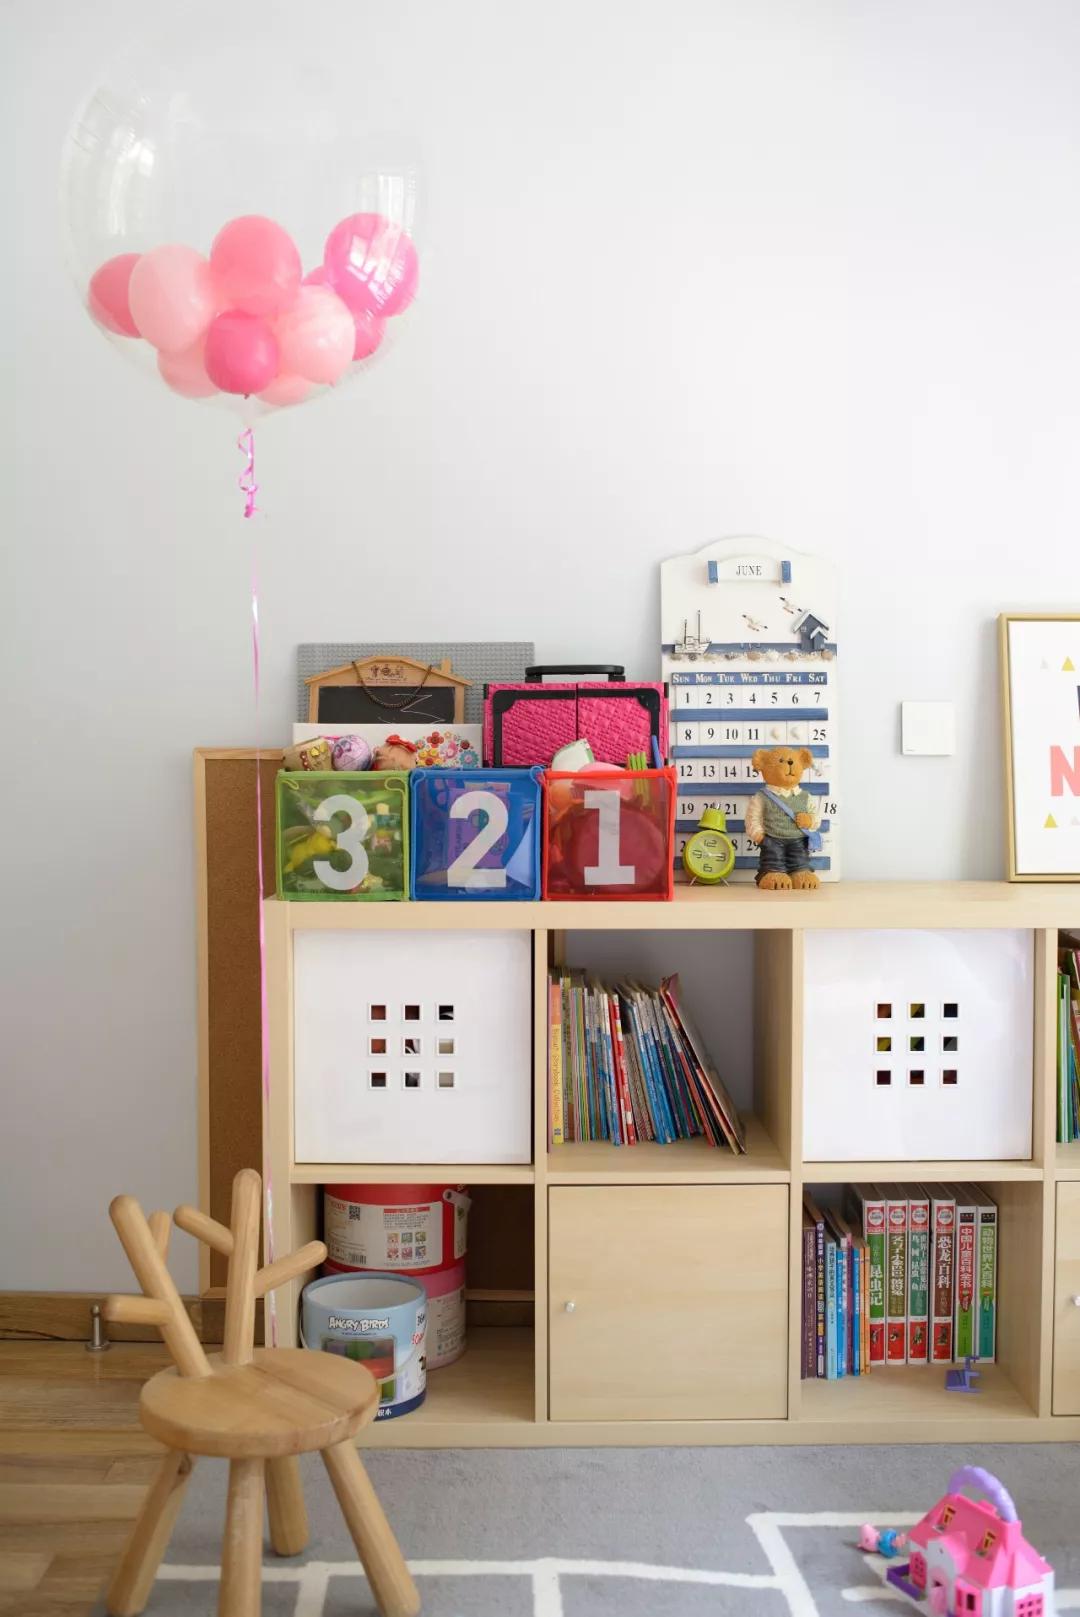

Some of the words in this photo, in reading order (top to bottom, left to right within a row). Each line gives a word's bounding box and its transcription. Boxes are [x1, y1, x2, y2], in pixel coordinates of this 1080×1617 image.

[736, 565, 762, 576] JUNE
[685, 692, 690, 704] 1
[706, 693, 712, 704] 2
[726, 693, 734, 704] 3
[750, 692, 756, 704] 4
[771, 692, 778, 704] 5
[792, 692, 799, 704] 6
[814, 692, 821, 703] 7
[685, 729, 692, 740] 8
[707, 728, 715, 739] 9
[725, 728, 738, 740] 10
[748, 728, 759, 740] 11
[813, 729, 826, 741] 25
[680, 765, 693, 777] 12
[702, 765, 715, 777] 13
[724, 765, 737, 778] 14
[746, 765, 760, 778] 15
[681, 803, 694, 815] 19
[725, 803, 737, 815] 21
[824, 802, 837, 815] 18
[313, 794, 369, 891] 3
[447, 791, 509, 887] 2
[583, 790, 635, 886] 1
